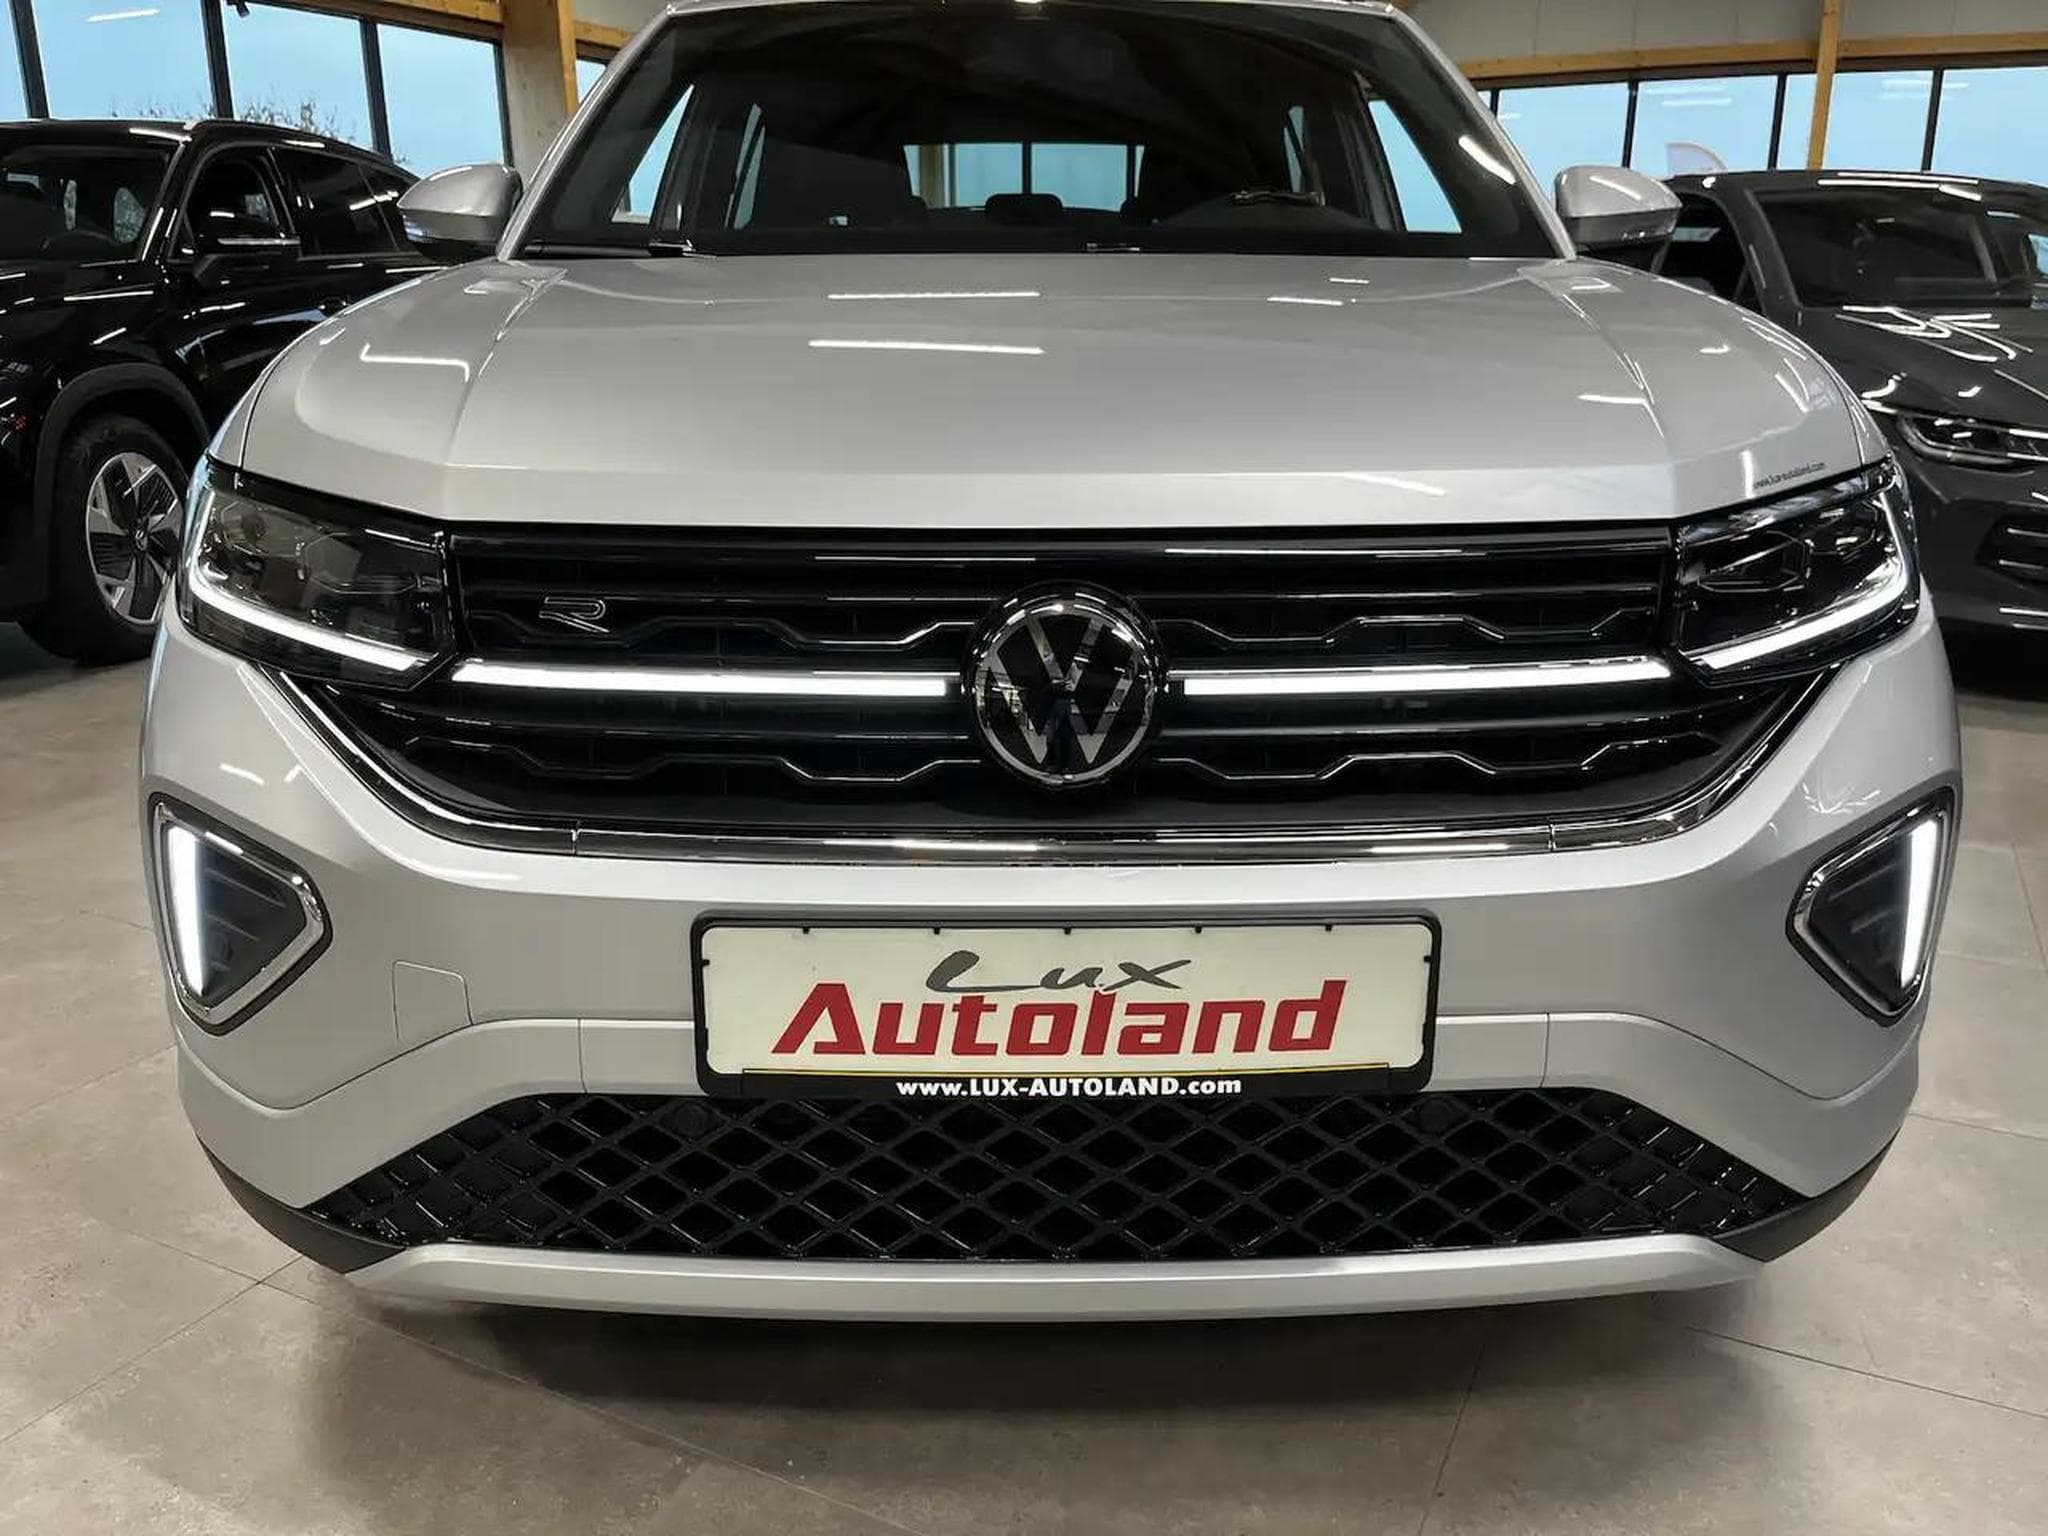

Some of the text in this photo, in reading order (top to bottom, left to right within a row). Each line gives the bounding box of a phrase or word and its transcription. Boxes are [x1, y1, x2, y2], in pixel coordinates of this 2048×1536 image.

[926, 950, 1192, 992] Lux
[771, 979, 1347, 1056] Autoland
[897, 1076, 1242, 1097] www.LUX-AUTOLAND.com
